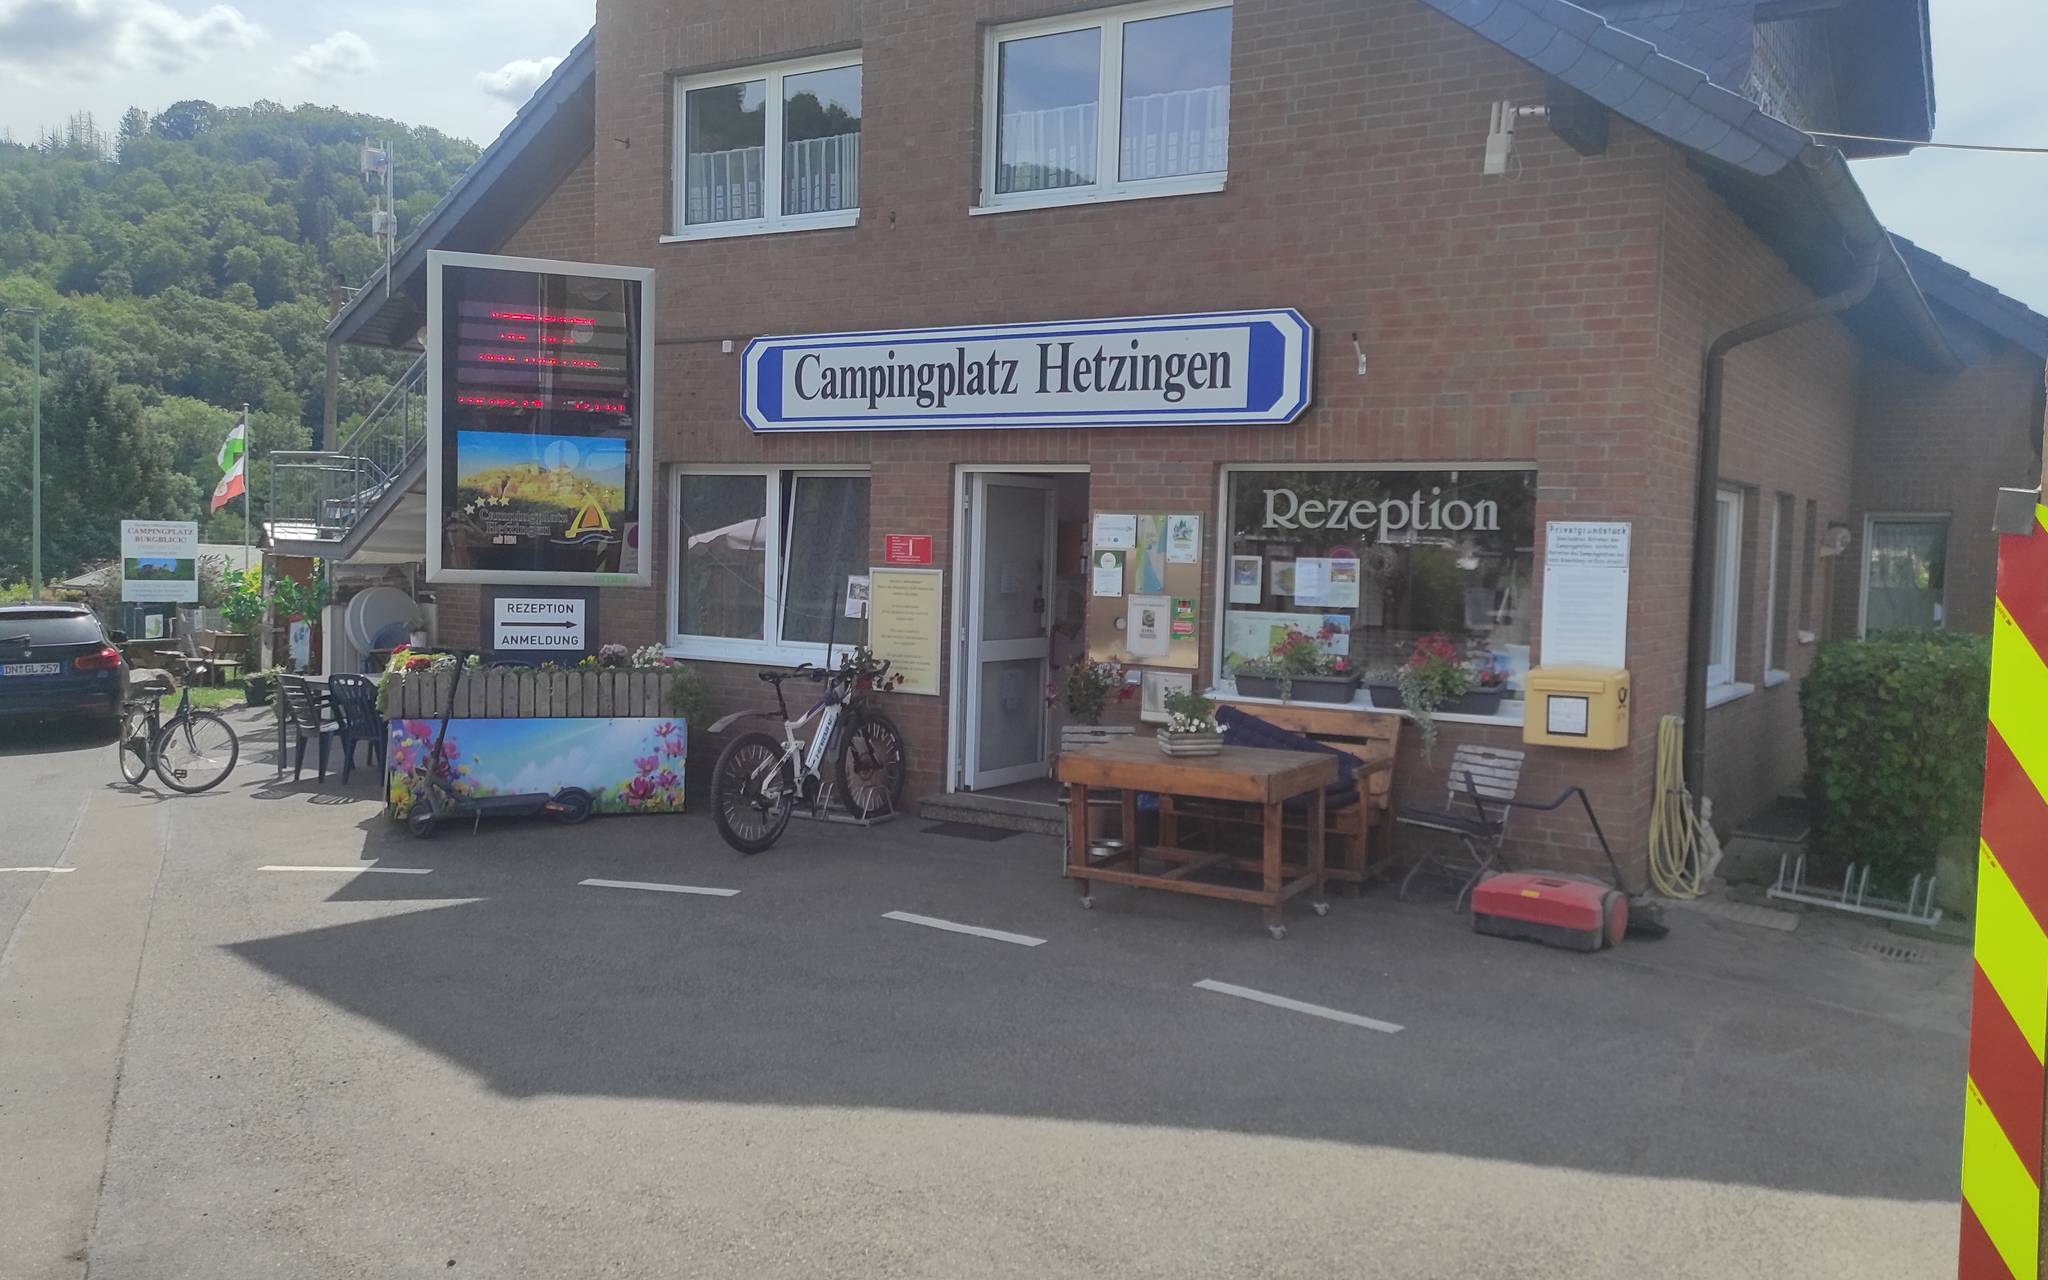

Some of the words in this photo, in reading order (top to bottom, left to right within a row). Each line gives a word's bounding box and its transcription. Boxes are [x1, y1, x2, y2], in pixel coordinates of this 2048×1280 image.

[794, 347, 1018, 410] Campingplatz
[1035, 340, 1232, 403] Hetzingen
[1262, 486, 1500, 544] Rezeption
[507, 603, 574, 614] REZEPTION
[502, 635, 579, 645] ANMELDUNG
[24, 665, 37, 673] GL
